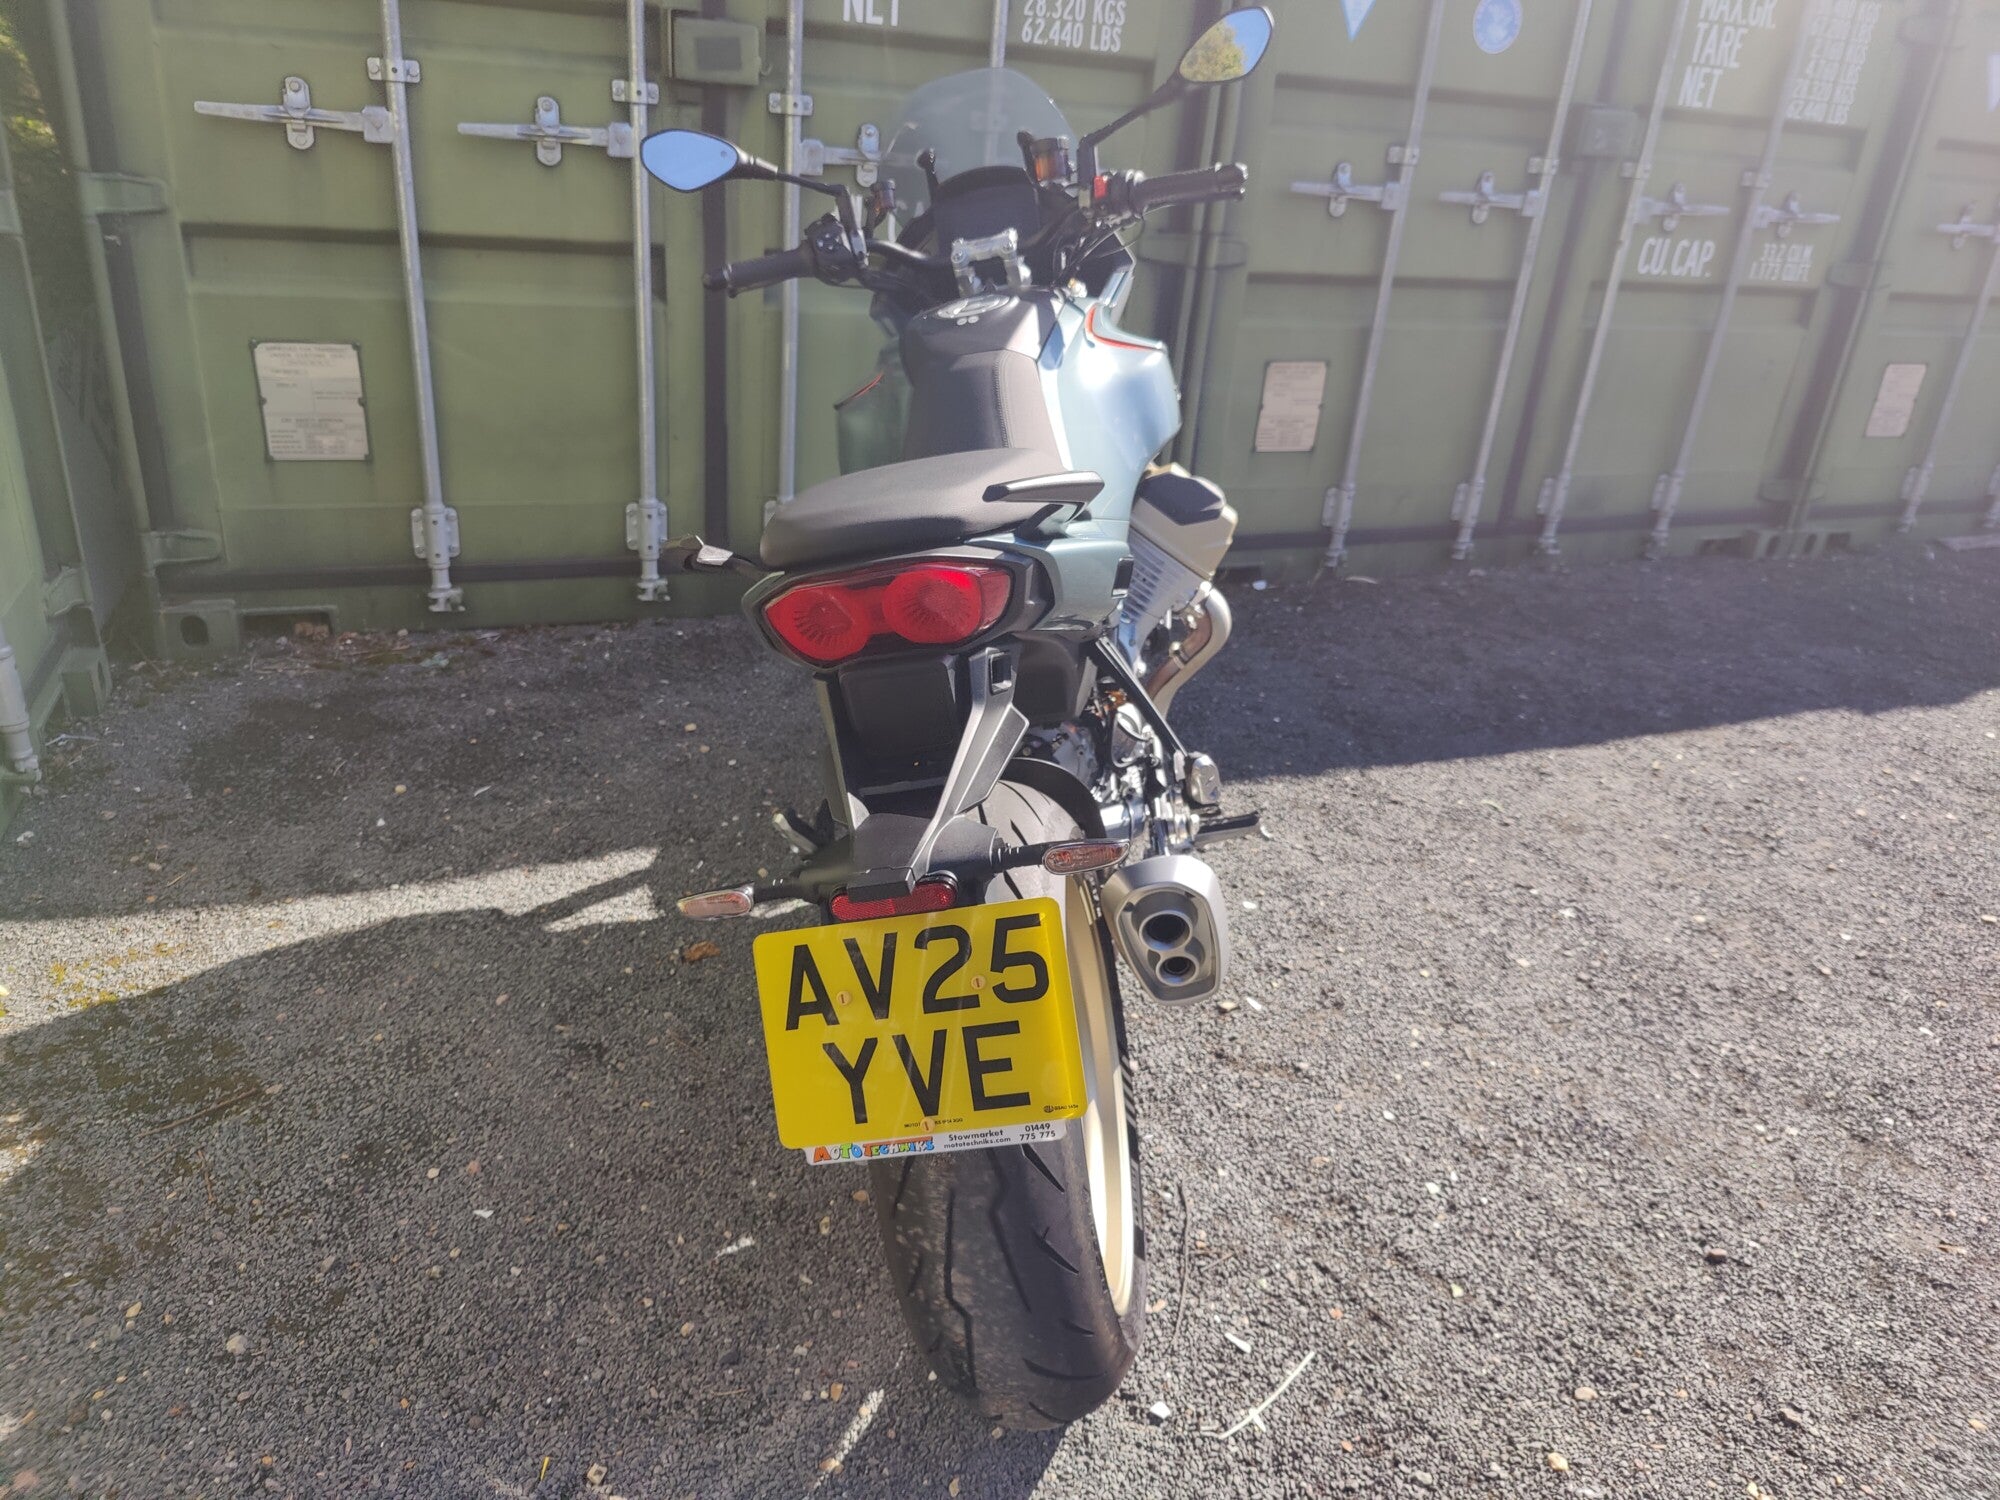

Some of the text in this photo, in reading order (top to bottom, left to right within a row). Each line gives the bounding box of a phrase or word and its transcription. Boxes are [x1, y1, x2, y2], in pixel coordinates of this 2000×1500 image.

[1092, 0, 1127, 26] KGS
[1021, 17, 1123, 53] 62,440 LBS
[1692, 22, 1749, 68] TARE
[1678, 65, 1724, 109] NET
[785, 913, 1050, 1031] AV25
[822, 1020, 1031, 1125] YVE
[943, 1136, 1011, 1149] mototechniks.com
[948, 1129, 1004, 1142] Stowmarket
[1019, 1130, 1056, 1142] 775 775
[1024, 1122, 1051, 1133] 01449
